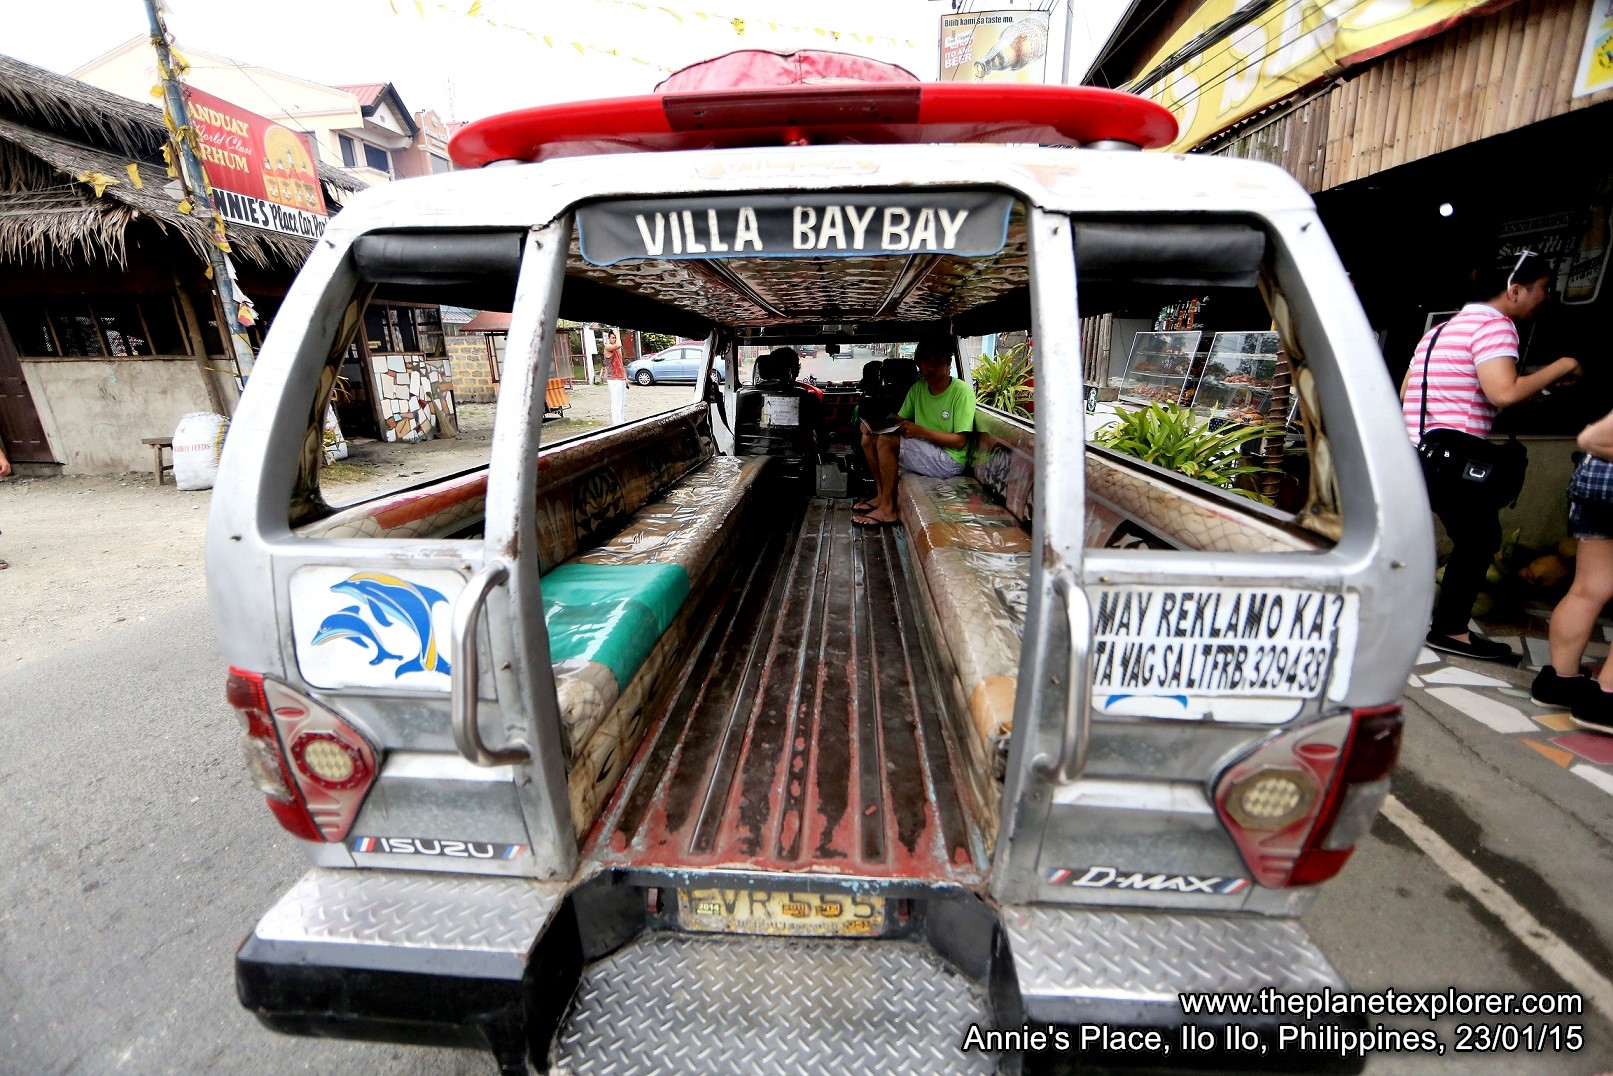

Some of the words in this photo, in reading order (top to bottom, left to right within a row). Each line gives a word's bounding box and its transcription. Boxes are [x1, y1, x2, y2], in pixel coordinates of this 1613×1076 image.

[945, 53, 972, 69] BEER
[187, 100, 250, 139] ANDUAY
[199, 142, 250, 174] RHUM
[225, 135, 253, 155] Class
[212, 188, 270, 227] NNIE'S
[269, 203, 299, 235] Place
[298, 210, 316, 237] Car
[635, 206, 763, 256] VILLA
[792, 205, 969, 251] BAYBAY
[191, 443, 211, 452] FEEDS
[1094, 591, 1152, 636] MAY
[1156, 592, 1283, 639] REKLAMO
[1289, 592, 1345, 641] KA?
[380, 837, 494, 858] ISUZU
[1072, 865, 1223, 893] D-MAX
